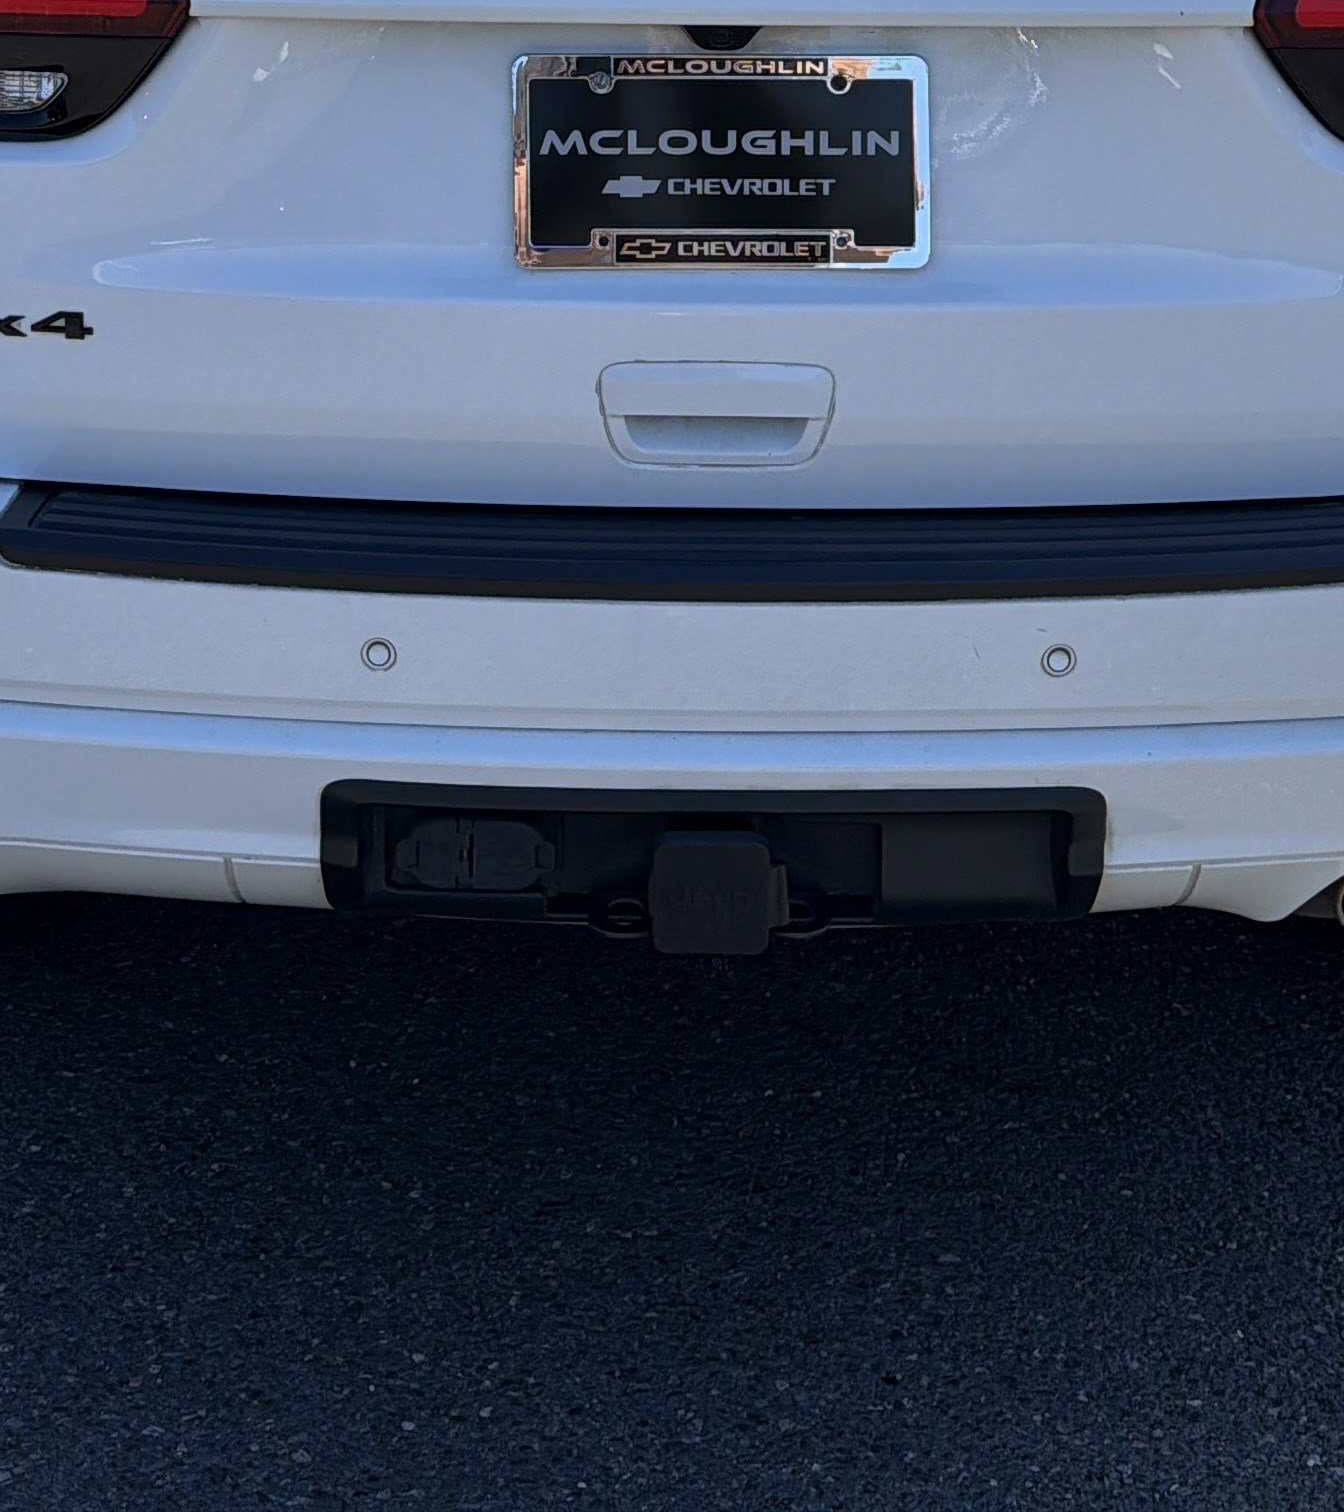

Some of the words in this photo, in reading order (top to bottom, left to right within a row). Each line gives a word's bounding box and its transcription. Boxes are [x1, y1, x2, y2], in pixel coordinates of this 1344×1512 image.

[617, 59, 825, 75] MCLOUGHLIN
[539, 129, 900, 156] MCLOUGHLIN
[667, 178, 837, 196] CHEVROLET
[677, 241, 827, 258] CHEVROLET
